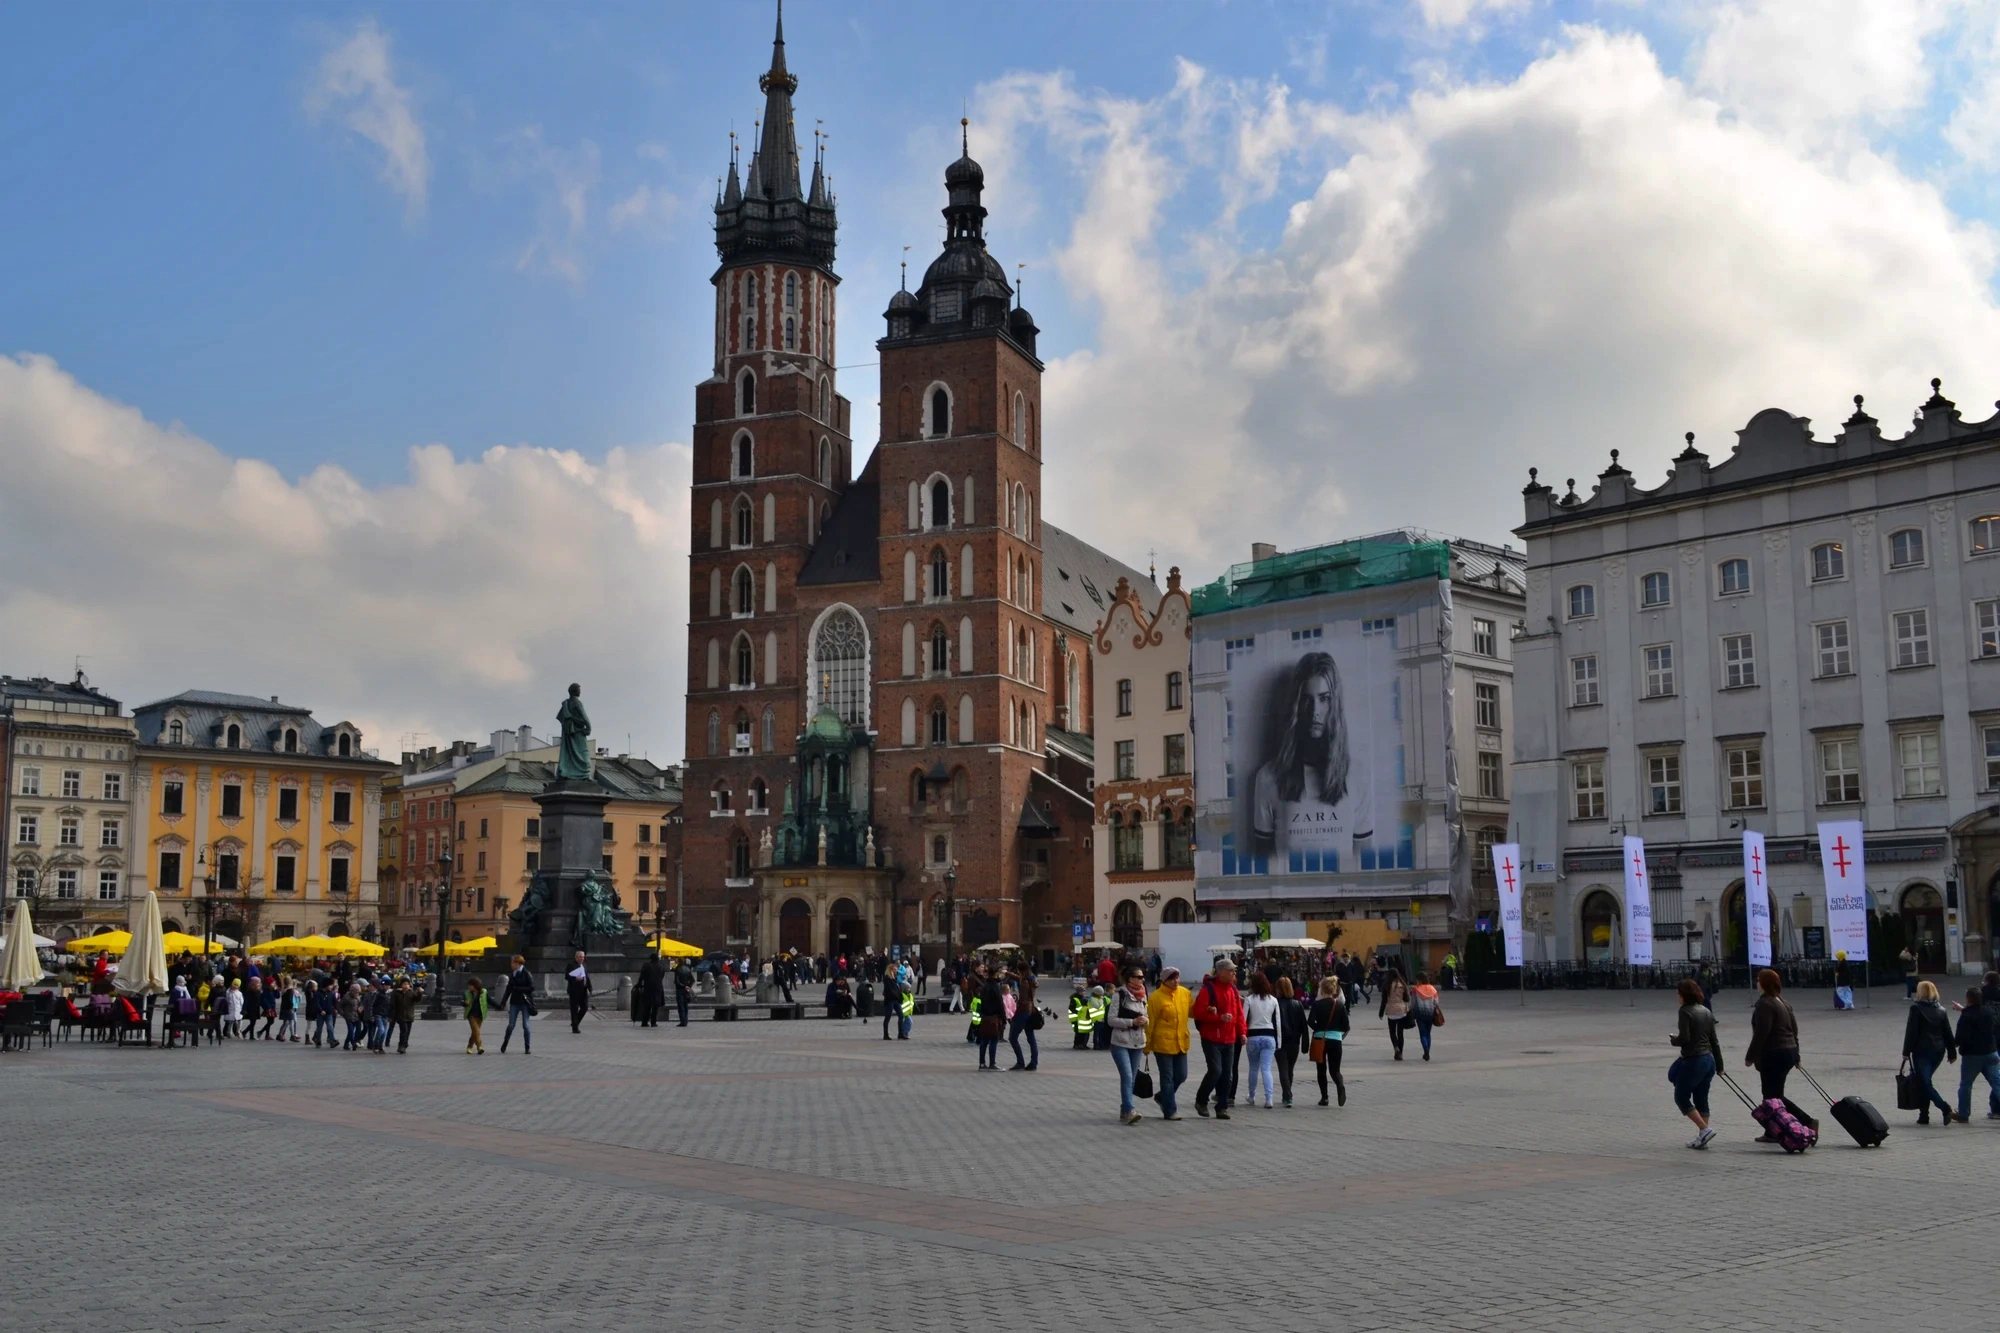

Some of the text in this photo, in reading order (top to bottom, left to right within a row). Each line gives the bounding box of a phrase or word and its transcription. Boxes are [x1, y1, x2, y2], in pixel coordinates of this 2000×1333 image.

[1291, 811, 1339, 823] ZARA
[1315, 826, 1343, 834] OTWARCIE
[1074, 925, 1082, 936] P
